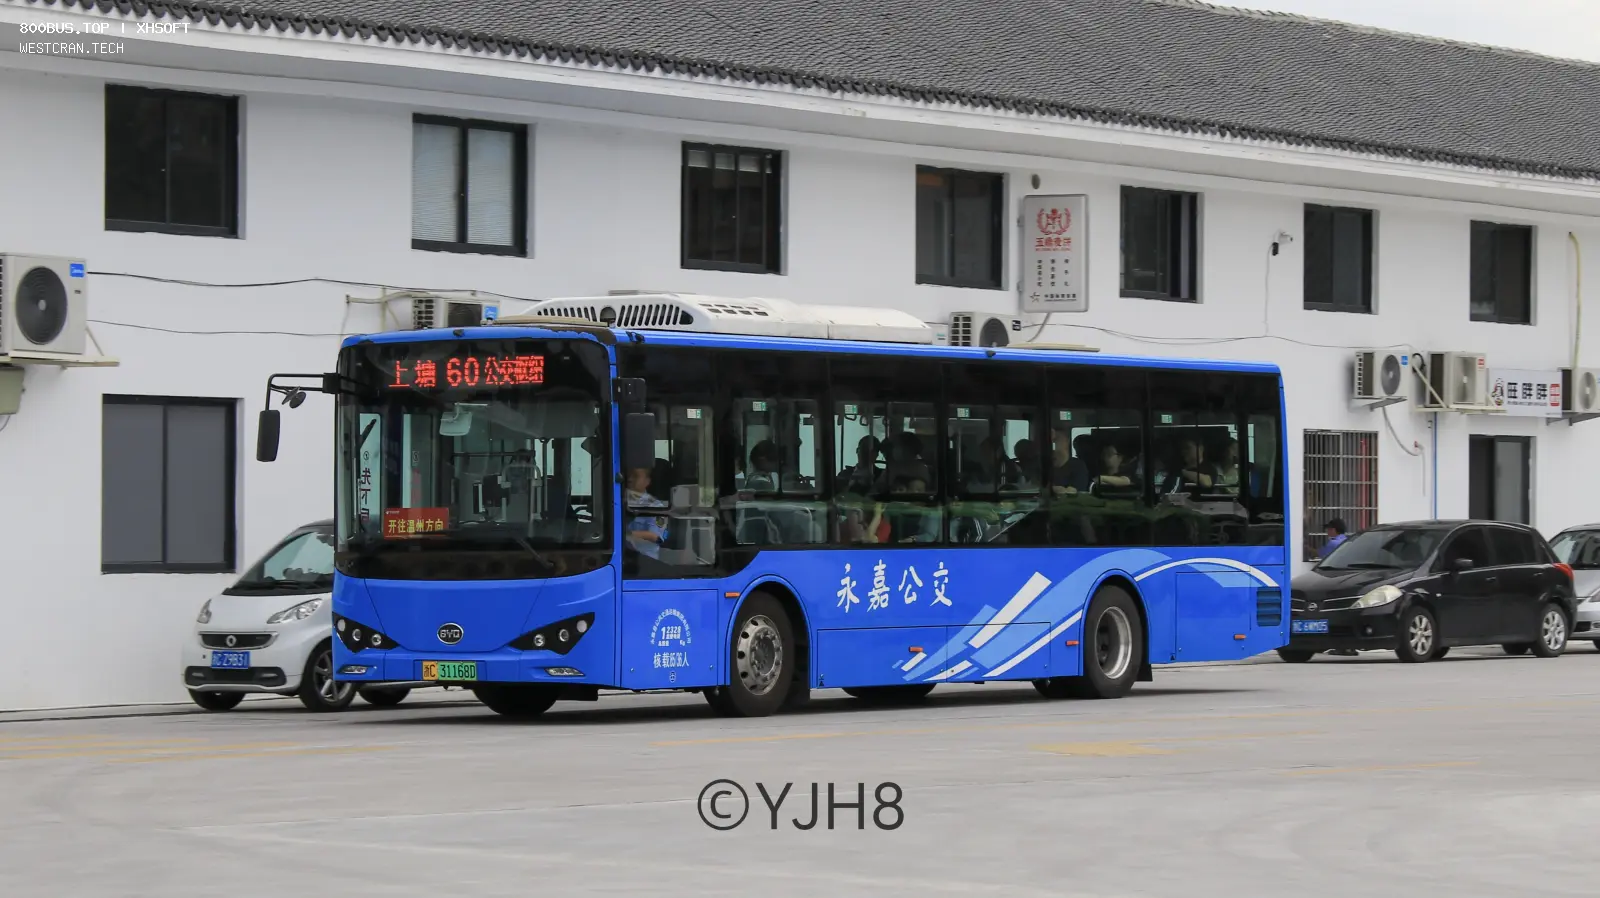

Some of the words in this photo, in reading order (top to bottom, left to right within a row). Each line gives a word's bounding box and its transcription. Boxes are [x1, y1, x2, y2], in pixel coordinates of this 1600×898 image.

[388, 360, 436, 387] 上塘
[446, 356, 480, 387] 60
[388, 519, 444, 533] 开往温州方向
[837, 559, 952, 613] 永嘉公交
[440, 629, 460, 638] BYD
